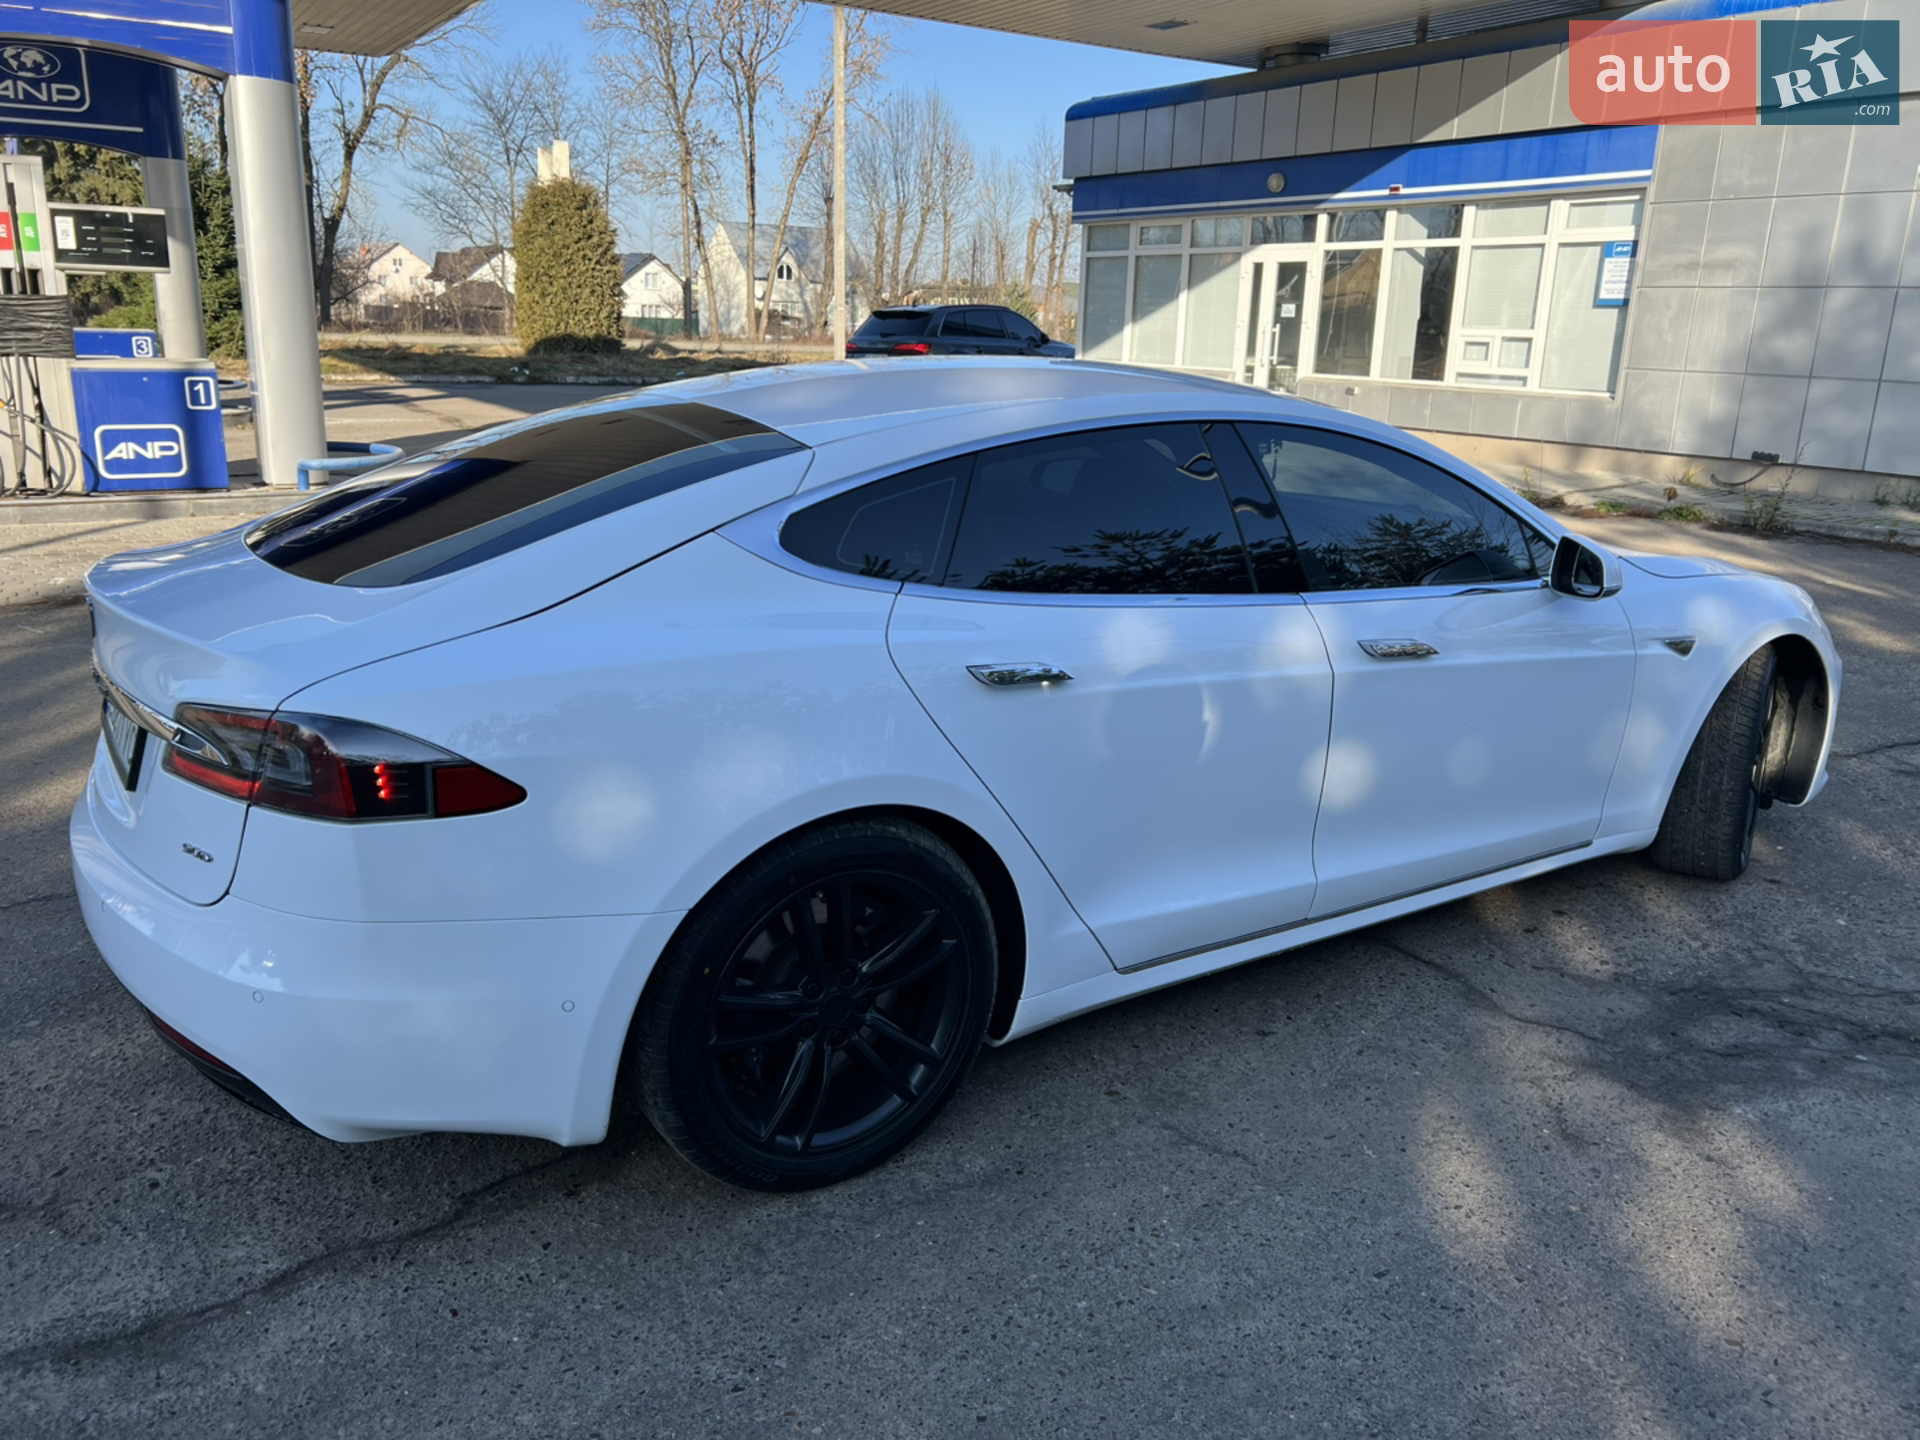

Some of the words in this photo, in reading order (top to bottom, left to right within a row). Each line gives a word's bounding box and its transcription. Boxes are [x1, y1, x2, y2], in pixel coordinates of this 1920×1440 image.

[136, 339, 148, 354] 3
[193, 382, 206, 405] 1
[104, 441, 179, 460] ANP
